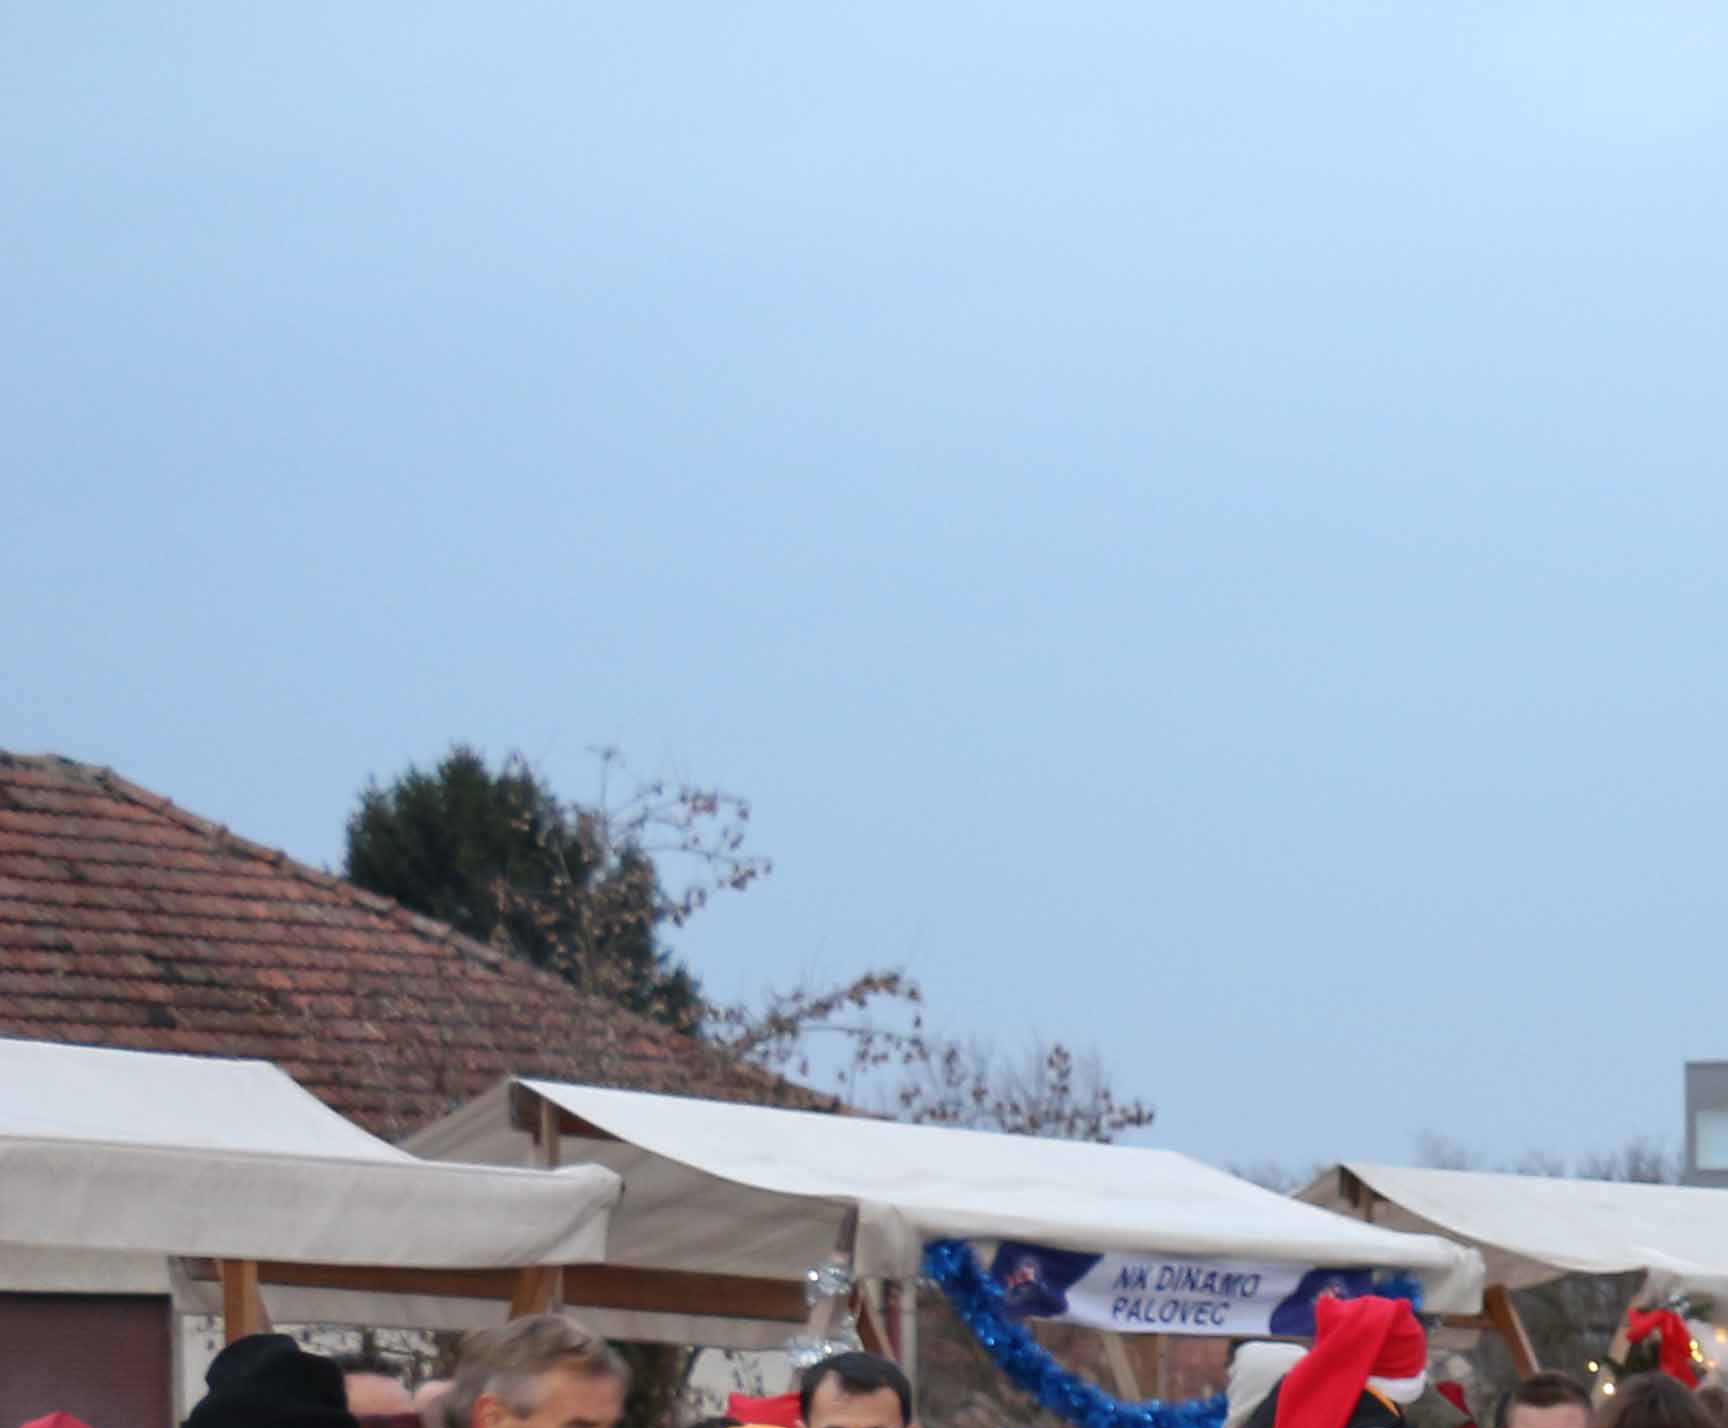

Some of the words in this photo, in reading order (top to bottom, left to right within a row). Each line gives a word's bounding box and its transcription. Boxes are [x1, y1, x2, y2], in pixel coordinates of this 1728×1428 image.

[1113, 1265, 1149, 1291] NK
[1153, 1265, 1262, 1298] DINAMO
[1112, 1297, 1230, 1326] PALOVEC
